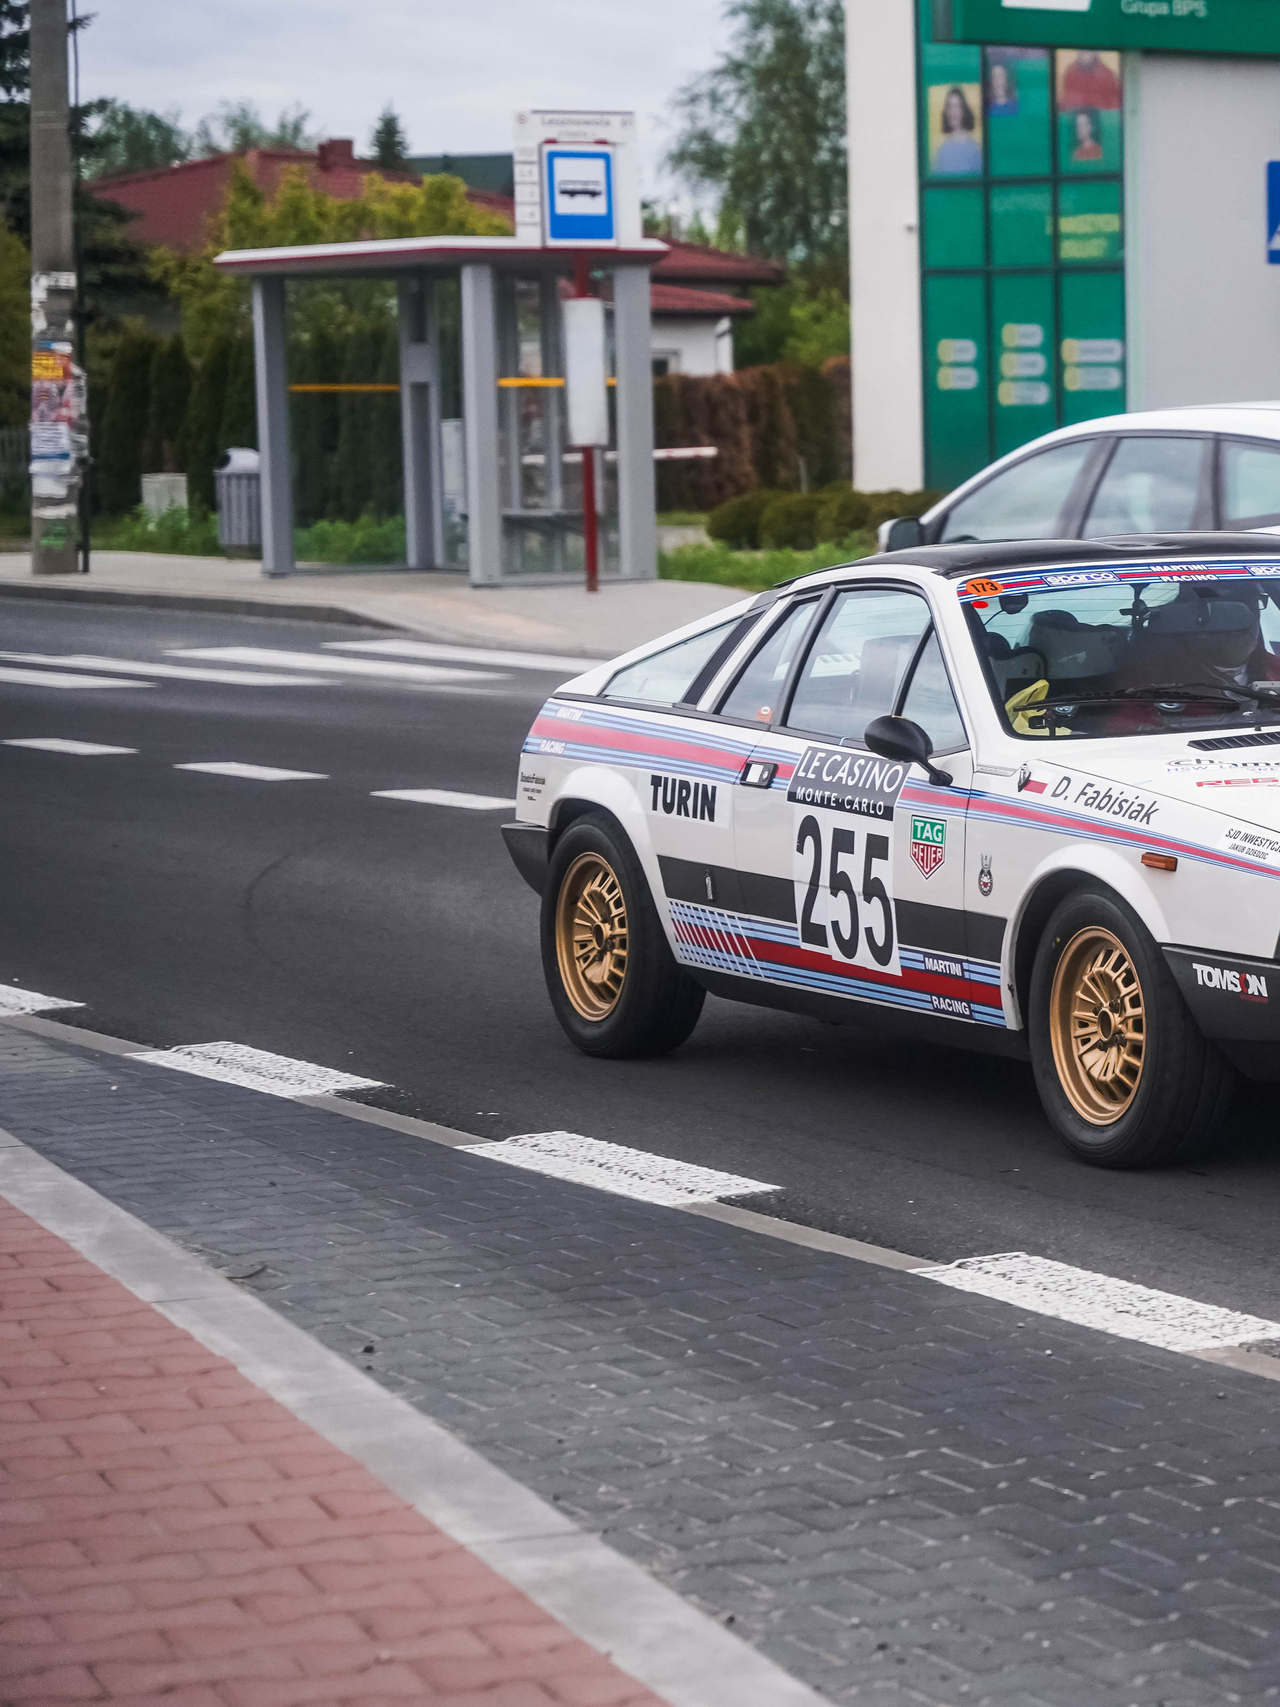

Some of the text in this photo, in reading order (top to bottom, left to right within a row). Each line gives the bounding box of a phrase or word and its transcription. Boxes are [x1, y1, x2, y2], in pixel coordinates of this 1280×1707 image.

[1149, 563, 1208, 573] MARTINI
[1160, 573, 1219, 583] RACING
[970, 580, 999, 594] 173
[1049, 571, 1114, 586] sparco
[556, 705, 583, 721] MARTINI
[538, 739, 566, 754] RACING
[797, 750, 904, 794] LE CASINO
[650, 774, 718, 822] TURIN
[1051, 776, 1160, 825] D. Fabisiak
[914, 821, 943, 842] TAG
[1225, 828, 1242, 840] SJD
[912, 844, 942, 872] HEUER
[796, 815, 894, 967] 255
[924, 957, 962, 977] MARTINI
[1192, 962, 1268, 998] TOMSON
[931, 996, 970, 1015] RACING
